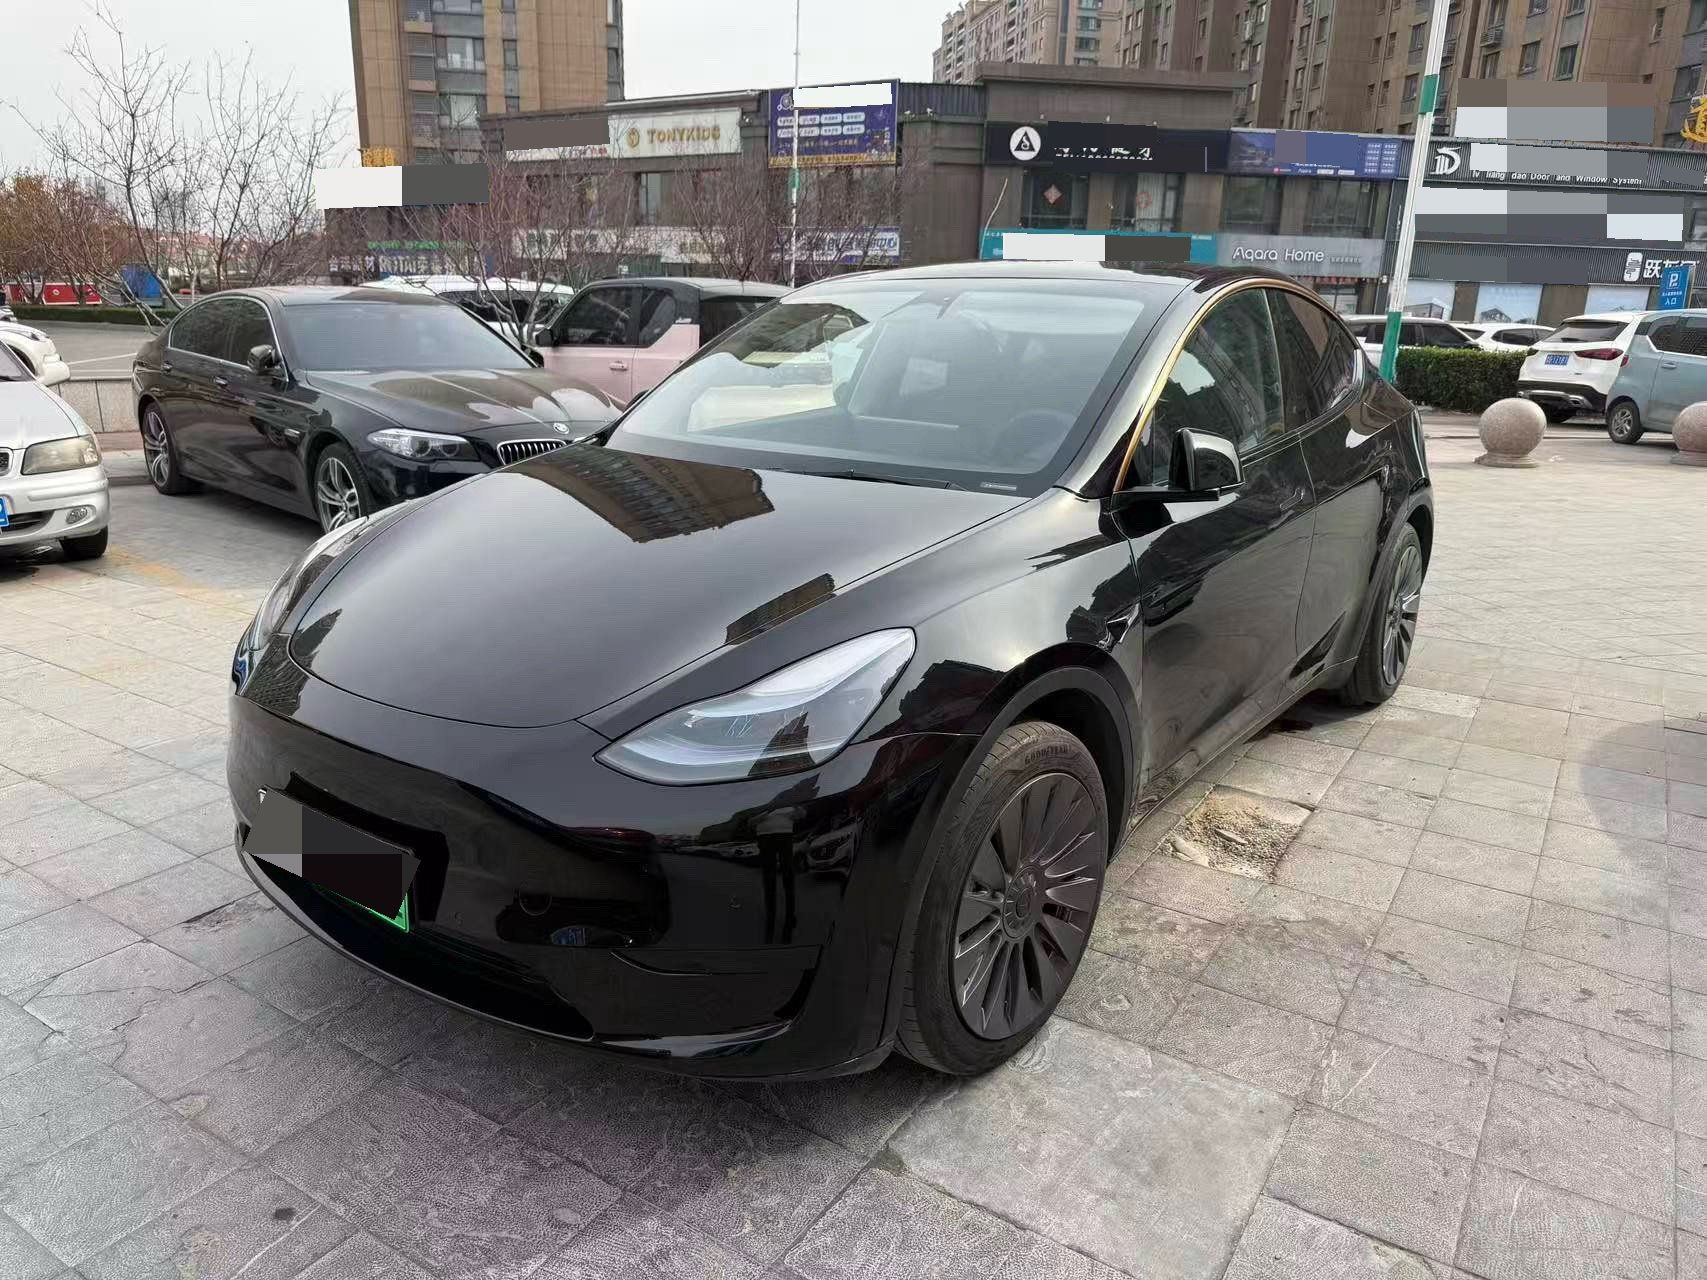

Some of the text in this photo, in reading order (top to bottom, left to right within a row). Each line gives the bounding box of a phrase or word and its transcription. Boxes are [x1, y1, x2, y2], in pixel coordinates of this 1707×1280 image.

[1530, 172, 1551, 181] Door
[1555, 174, 1571, 182] and
[1576, 175, 1608, 183] Window
[1284, 248, 1325, 263] Home
[1664, 297, 1677, 306] 入口
